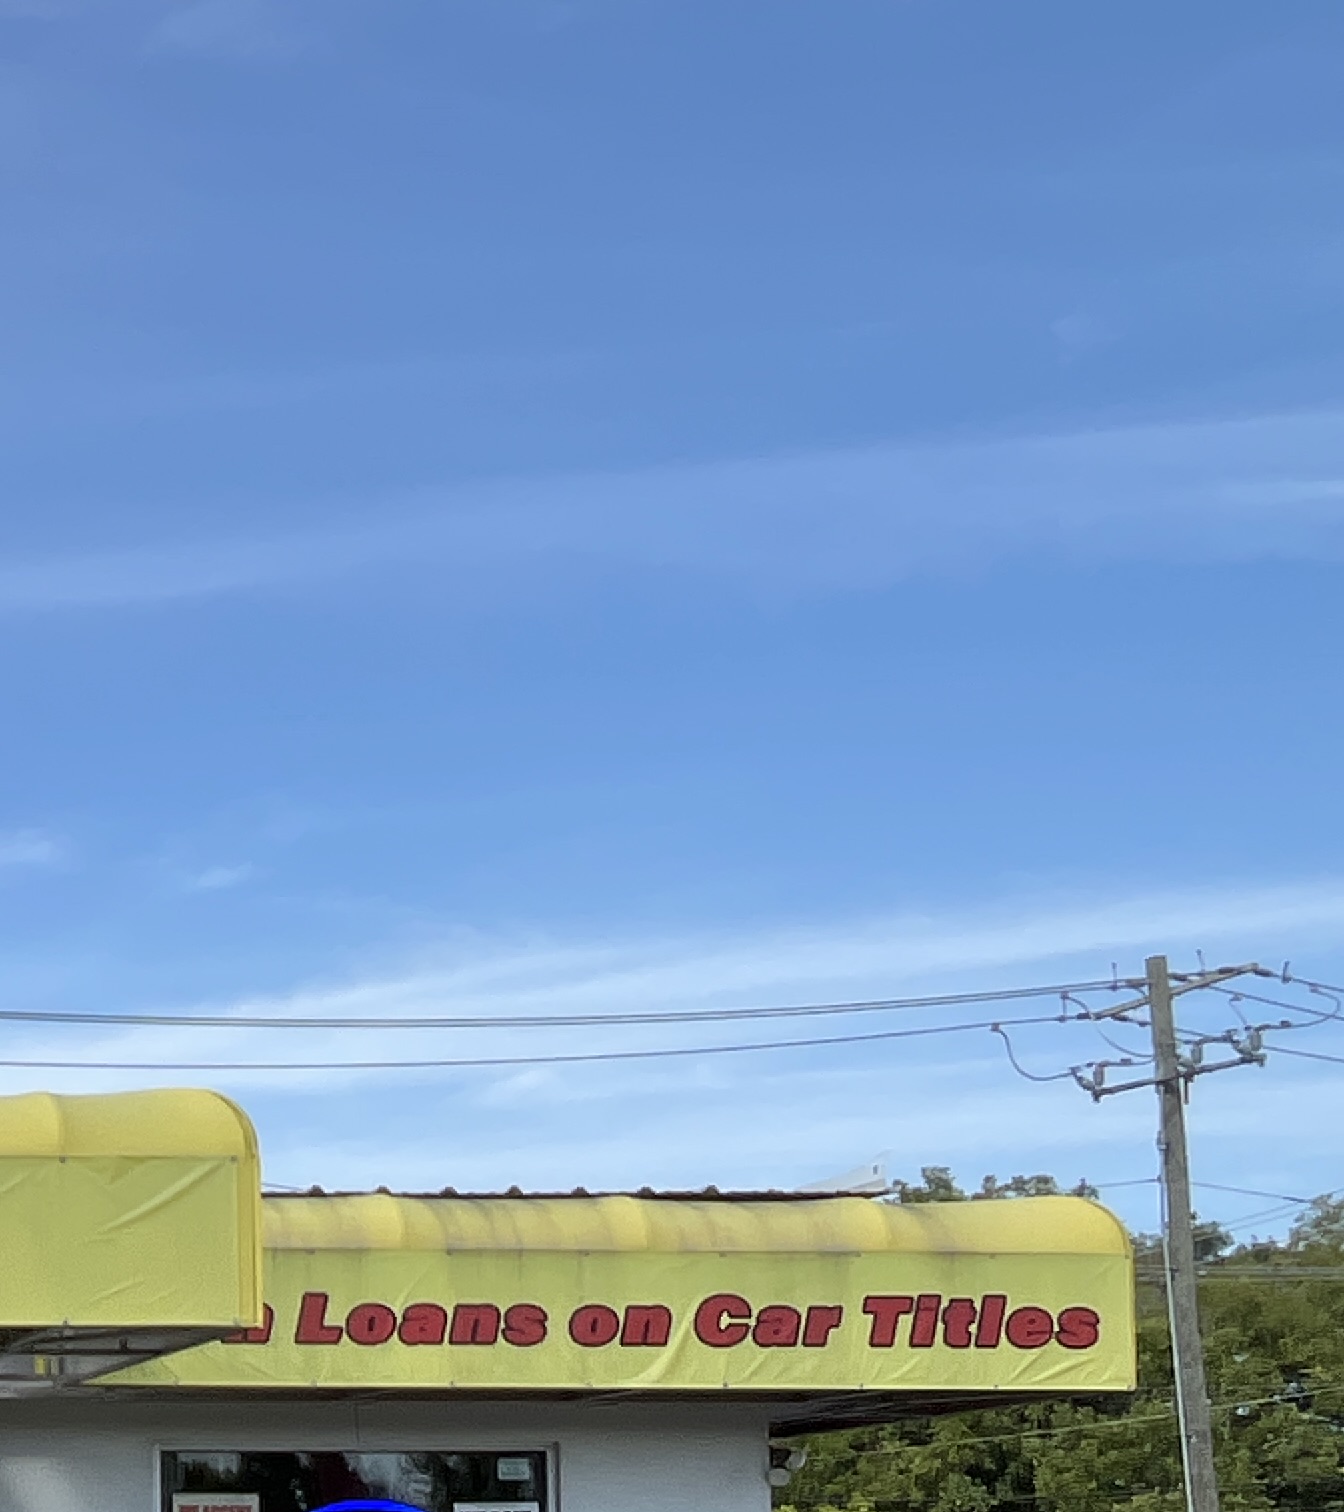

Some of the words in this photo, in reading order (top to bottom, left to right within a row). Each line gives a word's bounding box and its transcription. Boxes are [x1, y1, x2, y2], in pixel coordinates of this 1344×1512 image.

[295, 1292, 549, 1348] Loans
[568, 1304, 673, 1348] on
[693, 1294, 844, 1348] Car
[862, 1294, 1100, 1349] Titles
